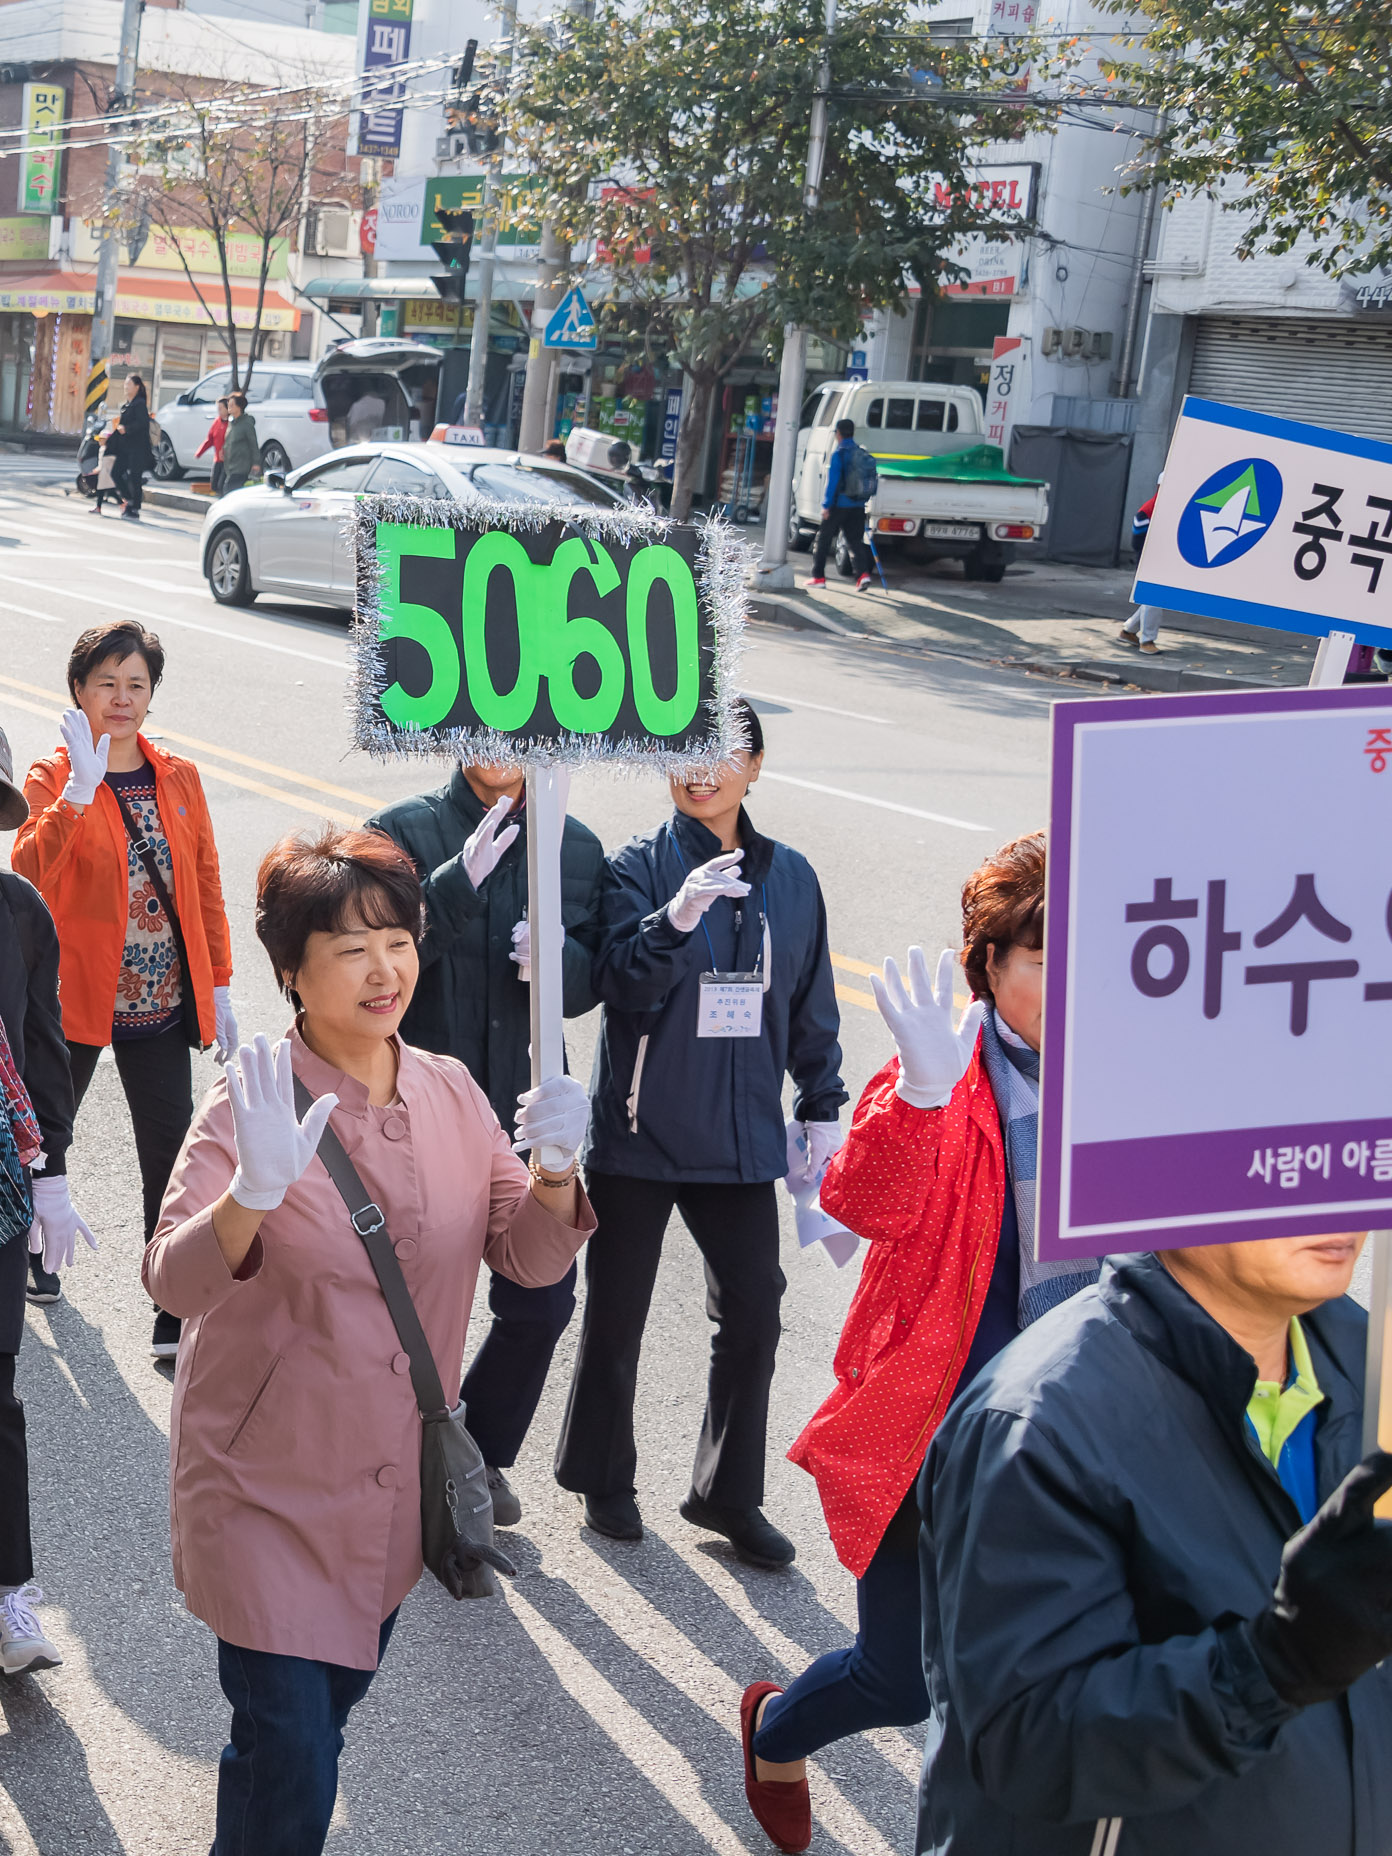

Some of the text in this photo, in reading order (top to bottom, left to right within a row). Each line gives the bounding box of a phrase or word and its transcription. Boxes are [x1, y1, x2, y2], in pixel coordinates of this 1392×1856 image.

[993, 1, 1035, 23] 커피숍
[381, 203, 420, 222] NOROO
[993, 365, 1015, 397] 정
[453, 433, 480, 444] TAXI
[988, 401, 1008, 445] 커피
[1292, 482, 1392, 594] 중곡
[375, 521, 701, 737] 5060
[1124, 873, 1392, 1037] 하수
[1246, 1142, 1332, 1189] 사람이
